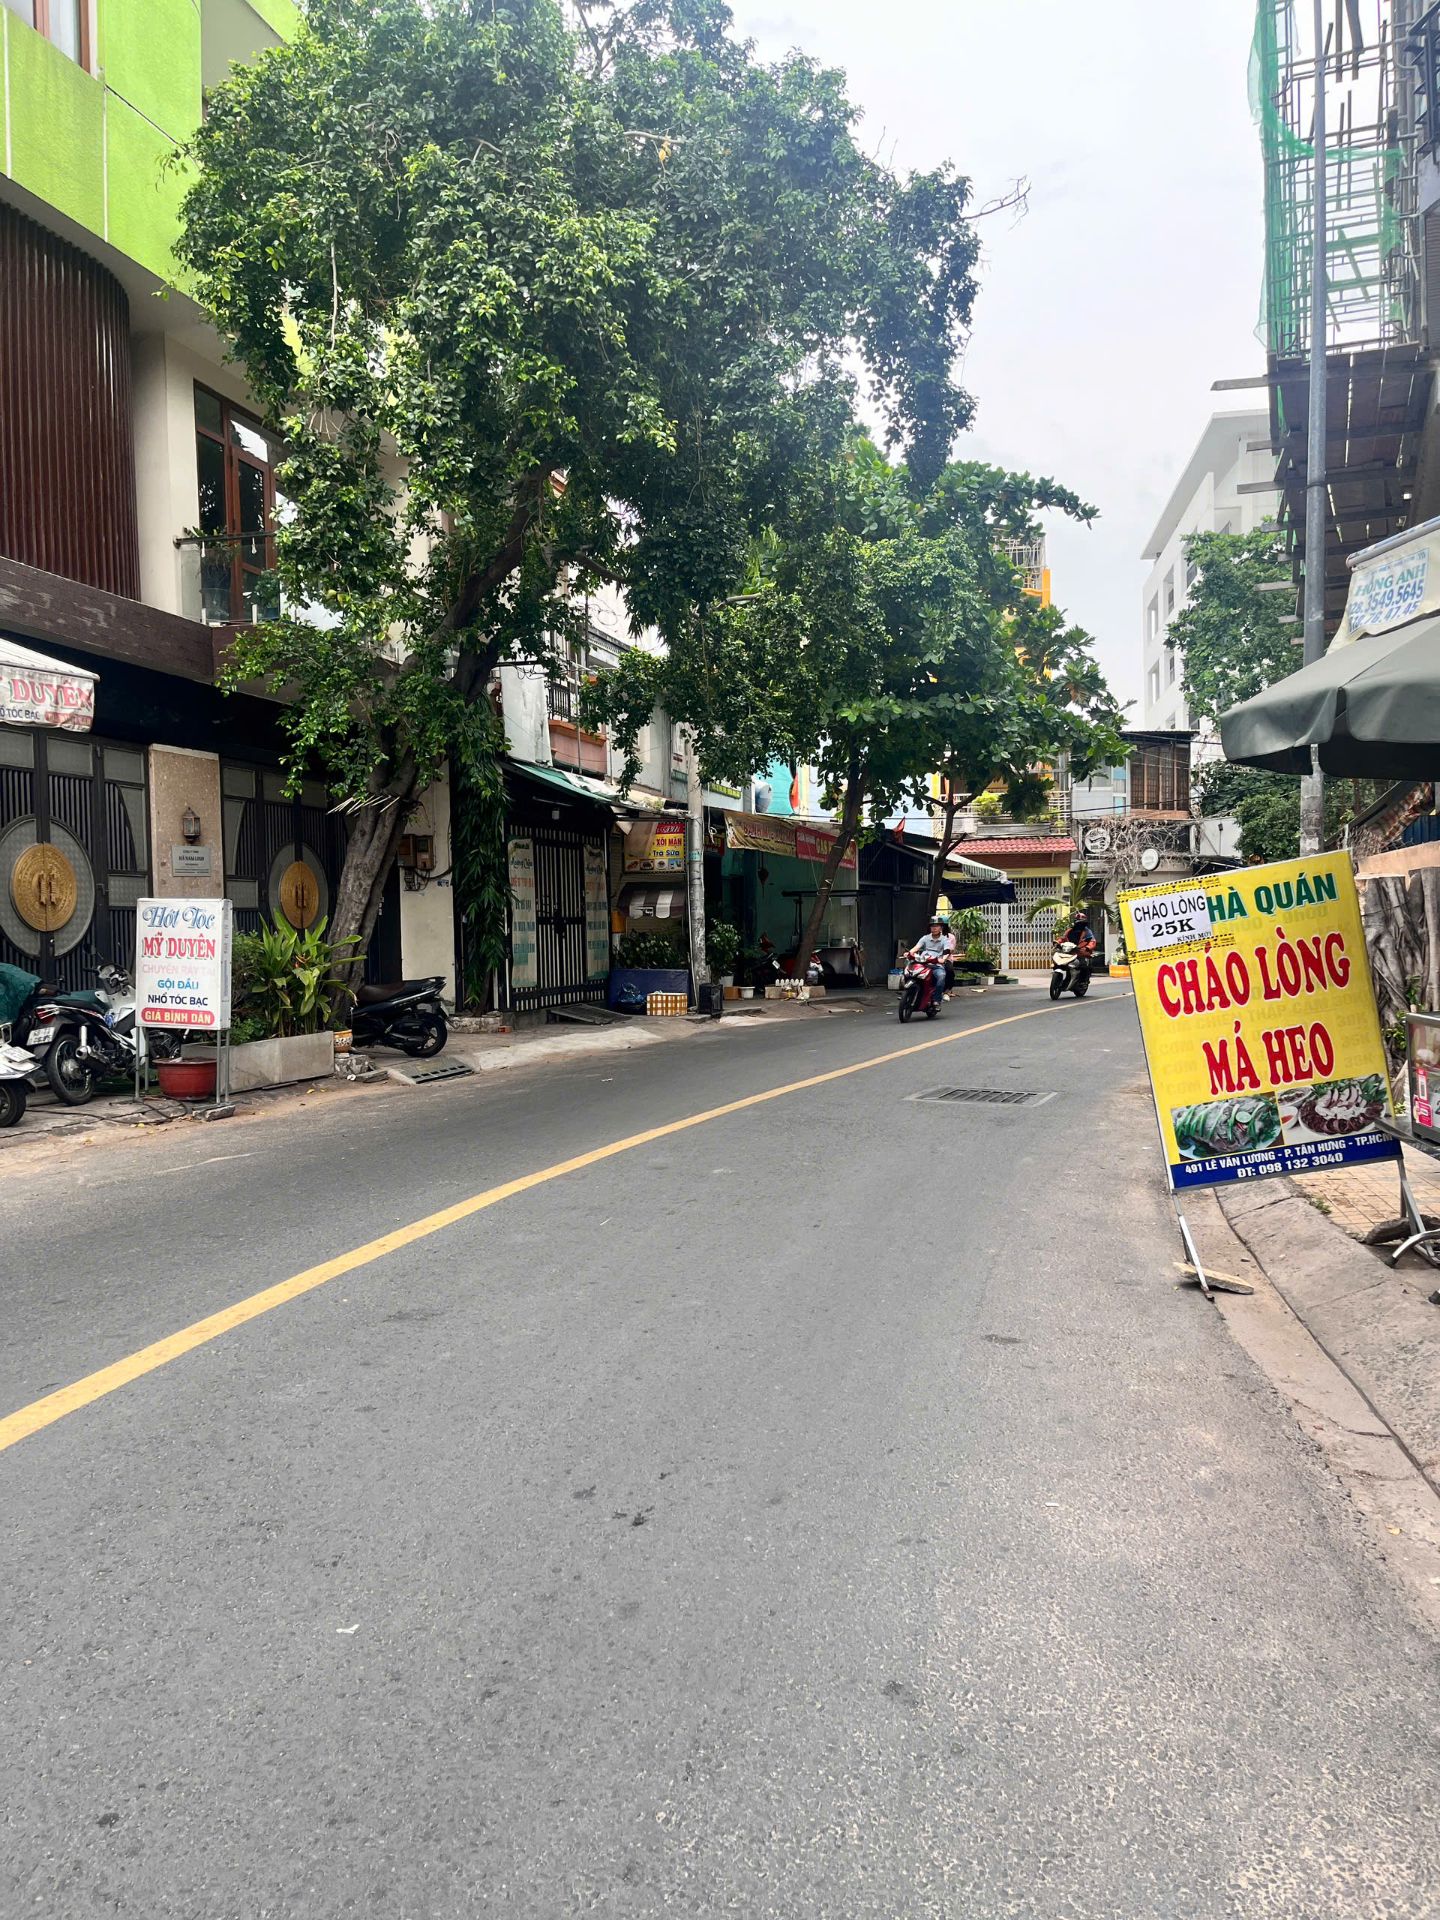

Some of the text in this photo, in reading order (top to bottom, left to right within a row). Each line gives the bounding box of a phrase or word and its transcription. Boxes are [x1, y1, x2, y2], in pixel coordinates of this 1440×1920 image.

[1396, 563, 1426, 584] ANH
[10, 679, 93, 710] DUYÊN
[1254, 872, 1338, 915] QUÁN
[1134, 895, 1206, 922] CHÁO LÒNG
[1151, 918, 1195, 938] 25K
[142, 931, 216, 960] MỸ DUYÊN
[157, 979, 175, 990] GỘI
[1157, 926, 1350, 1018] CHÁO LÒNG
[147, 992, 208, 1007] NHỔ TÓC BẠC
[144, 1008, 161, 1021] GIÁ
[164, 1009, 188, 1023] BÌNH
[1202, 1020, 1261, 1095] MÁ
[1262, 1022, 1334, 1085] HEO
[1184, 1162, 1203, 1174] 491
[1205, 1158, 1218, 1171] LÊ
[1219, 1155, 1240, 1169] VĂN
[1243, 1151, 1275, 1165] LƯƠNG
[1284, 1147, 1294, 1158] P.
[1295, 1144, 1316, 1156] TÂN
[1317, 1139, 1346, 1153] HƯNG
[1237, 1152, 1344, 1178] ĐT: 098 132 3040
